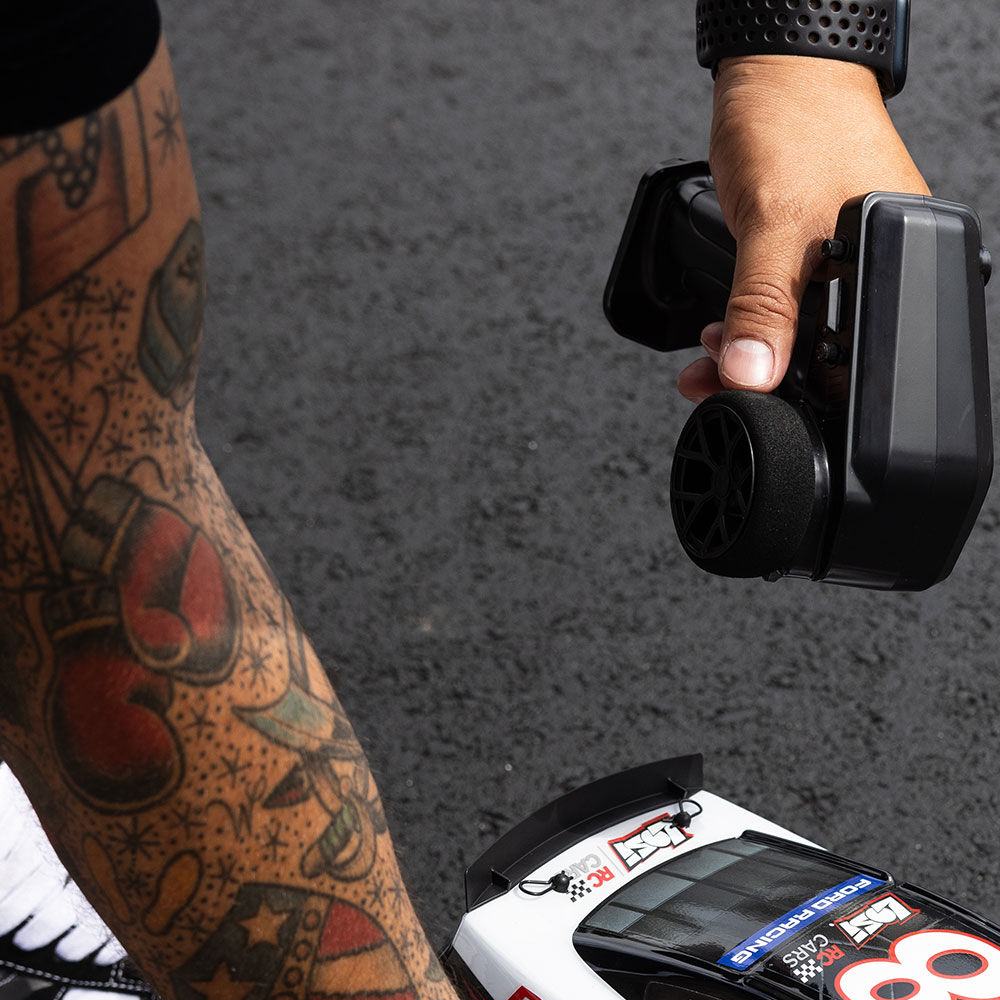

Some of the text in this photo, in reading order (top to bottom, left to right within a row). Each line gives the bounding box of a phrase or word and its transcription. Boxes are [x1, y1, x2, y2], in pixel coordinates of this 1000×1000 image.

[587, 865, 615, 888] RC
[730, 878, 872, 964] FORD RACING
[782, 933, 829, 968] CARS
[816, 943, 845, 967] RC
